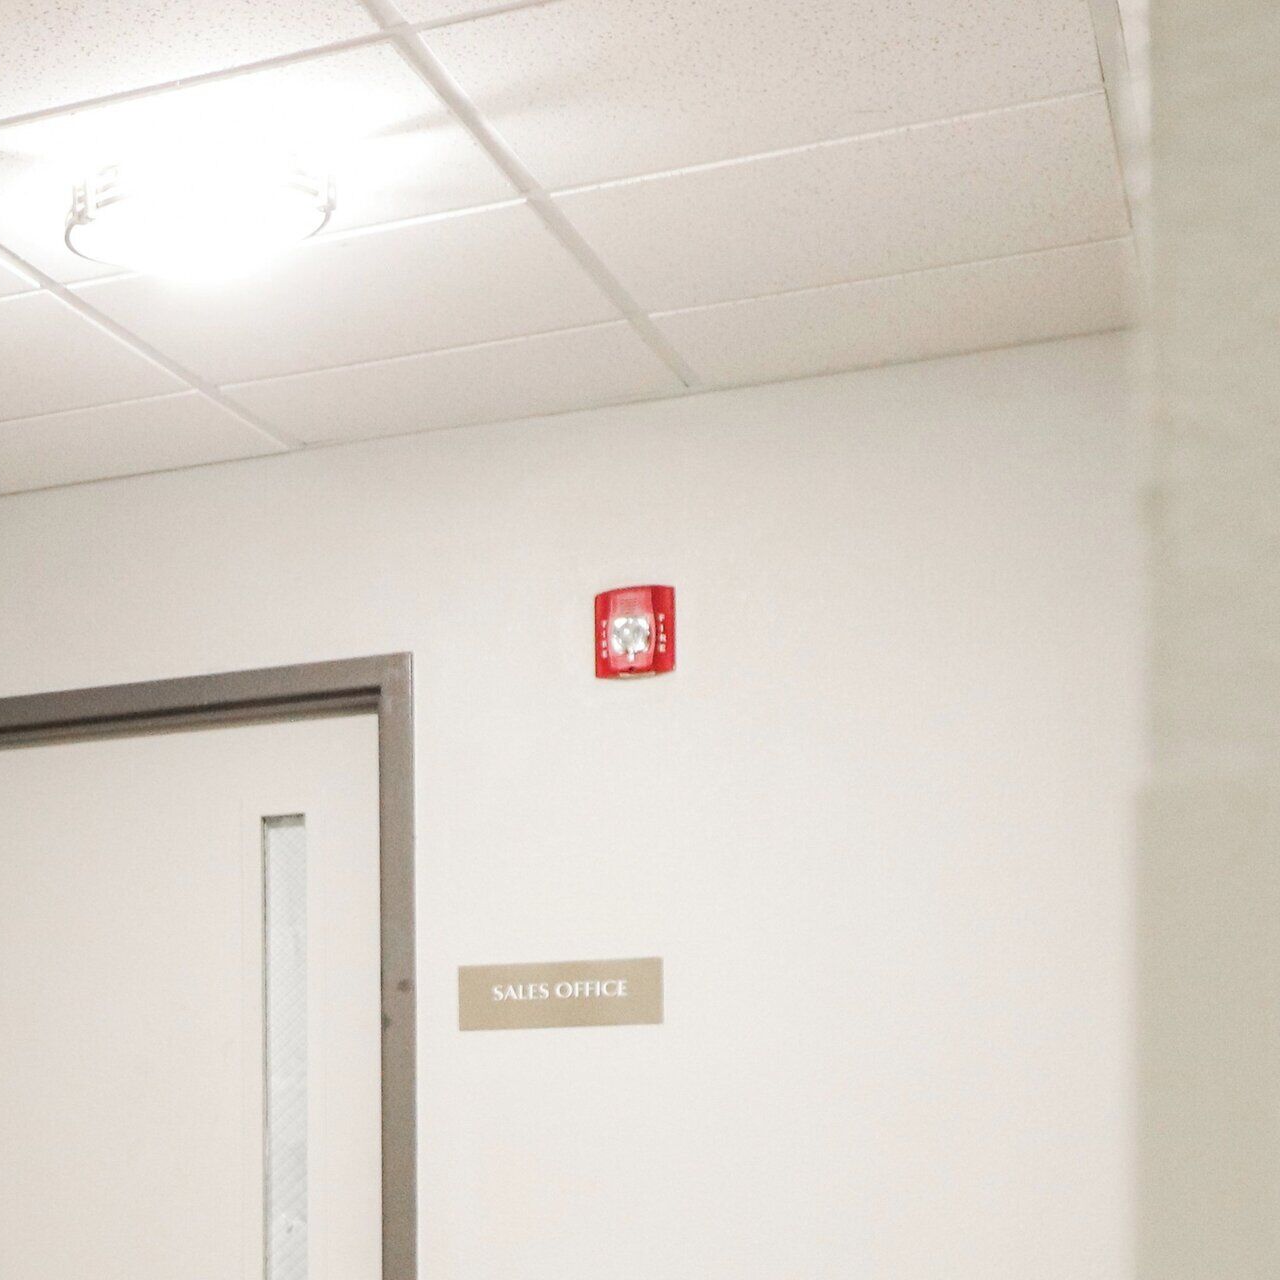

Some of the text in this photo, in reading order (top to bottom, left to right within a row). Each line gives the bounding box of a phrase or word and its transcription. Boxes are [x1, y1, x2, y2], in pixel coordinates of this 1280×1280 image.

[657, 613, 667, 653] FIRE
[493, 979, 629, 1001] SALES OFFICE
